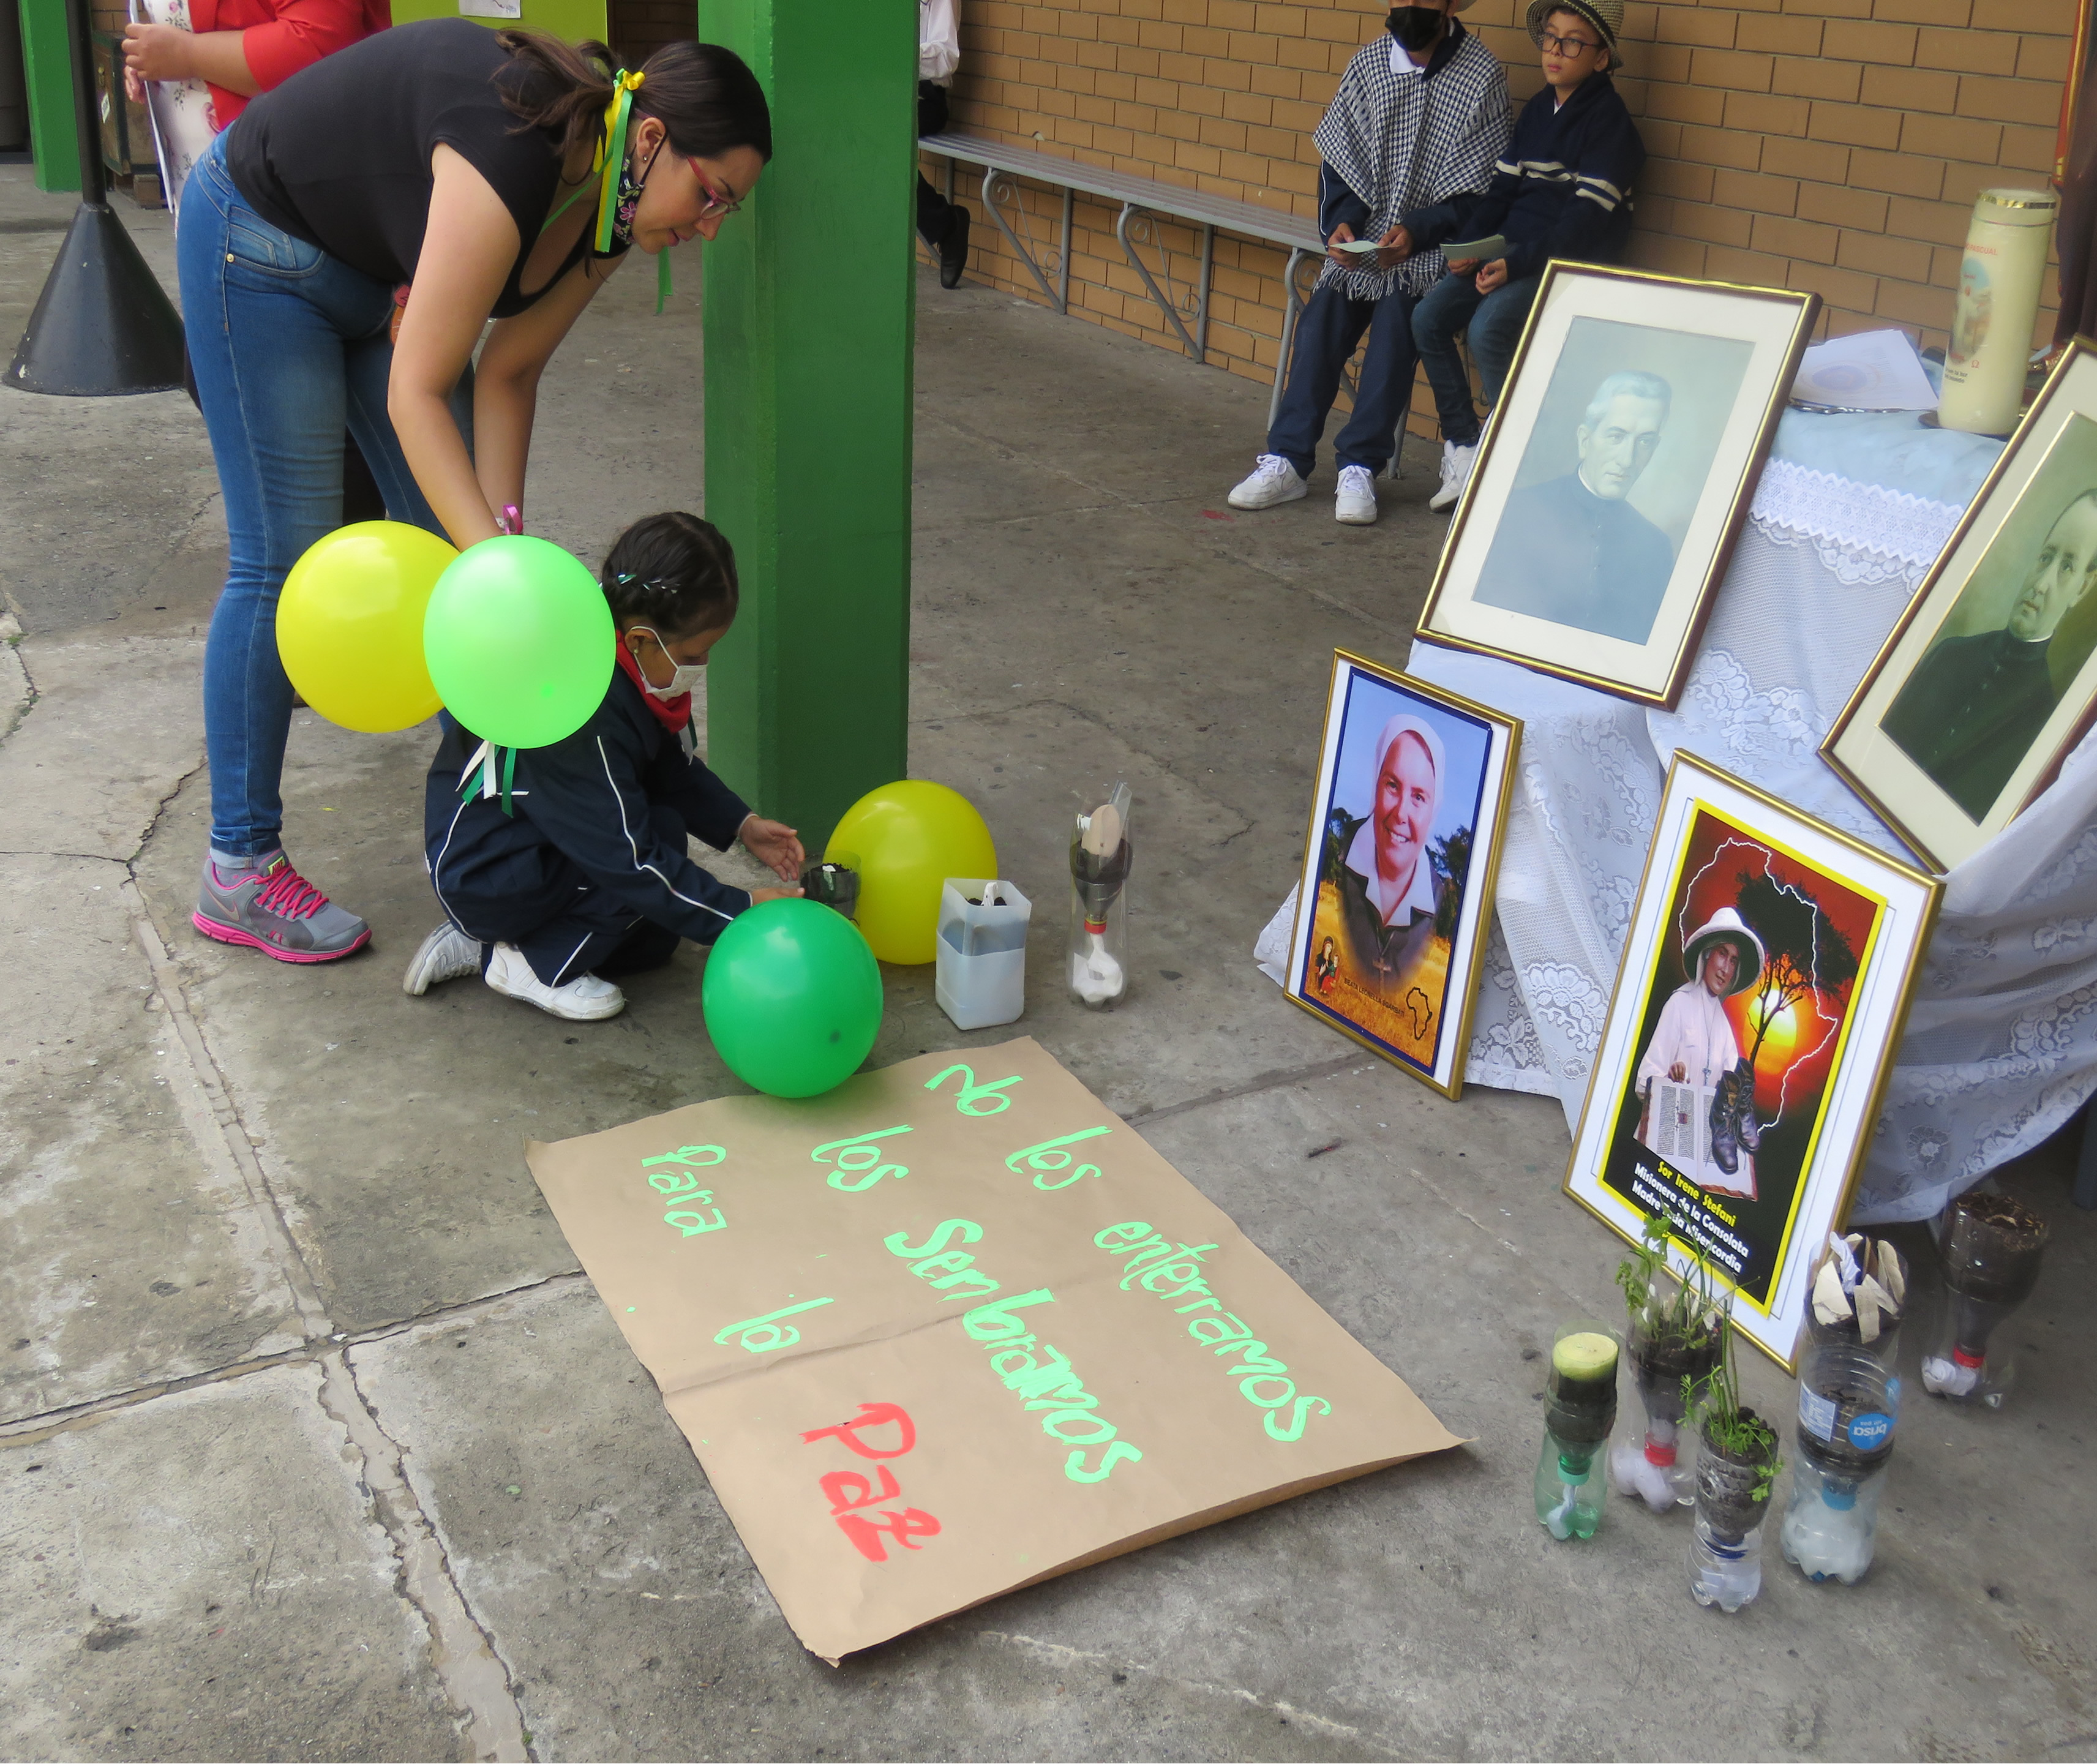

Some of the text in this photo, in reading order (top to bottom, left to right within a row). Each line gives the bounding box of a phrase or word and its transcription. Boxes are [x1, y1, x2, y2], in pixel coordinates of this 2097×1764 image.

[1344, 978, 1359, 991] BEATA
[811, 1124, 913, 1192] los
[1632, 1180, 1661, 1211] Madre
[1634, 1162, 1749, 1258] Misionera de la Consolata
[1657, 1161, 1736, 1227] Sor Irene Stefani
[641, 1144, 835, 1353] Para la
[1005, 1125, 1112, 1190] los
[1094, 1222, 1332, 1442] enterramos
[1853, 1423, 1887, 1437] brisa
[799, 1402, 942, 1563] Paz
